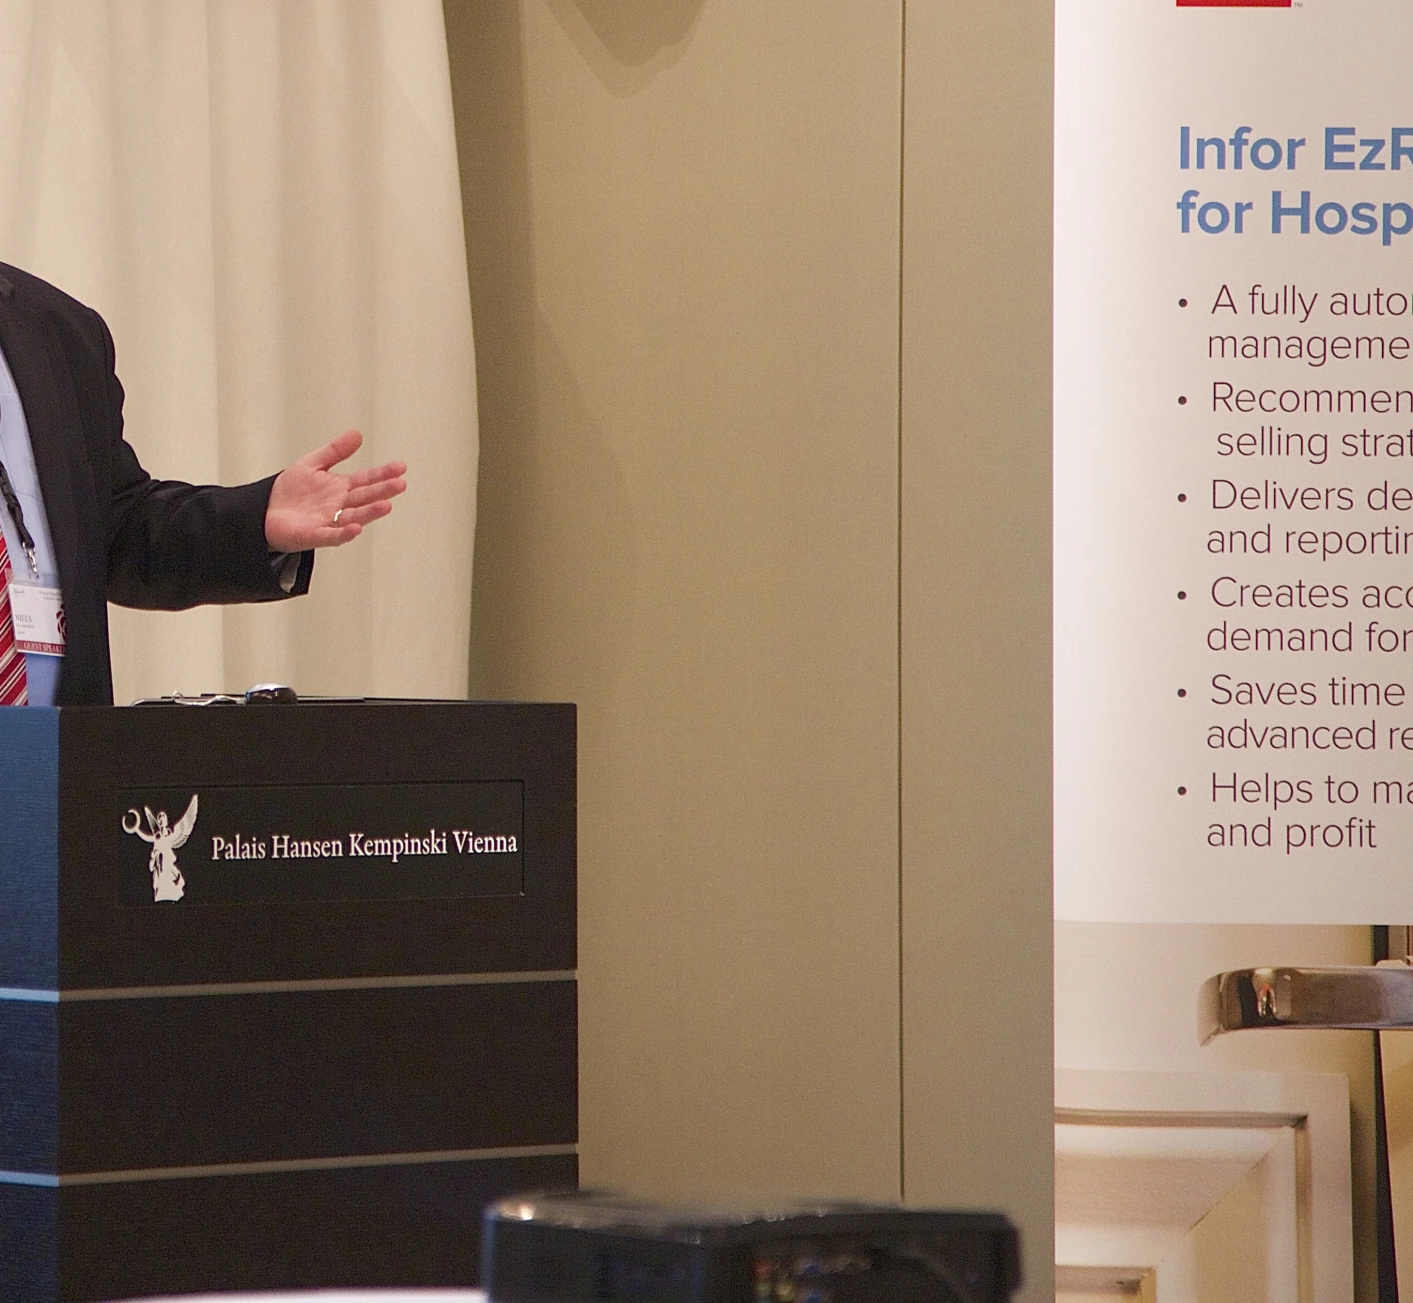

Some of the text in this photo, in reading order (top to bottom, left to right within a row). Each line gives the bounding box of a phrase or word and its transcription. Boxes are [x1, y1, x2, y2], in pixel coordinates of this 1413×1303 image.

[1181, 126, 1306, 170] Infor
[1177, 190, 1413, 246] for Hosp
[1211, 284, 1413, 323] A fully auto
[1209, 336, 1410, 367] manageme
[1213, 382, 1413, 413] Recommen
[1218, 426, 1413, 464] selling strat
[1213, 479, 1413, 511] Delivers de
[1207, 523, 1270, 553] and
[1212, 577, 1348, 608] Creates
[24, 642, 42, 652] GUEST
[1207, 621, 1413, 652] demand for
[1212, 674, 1405, 706] Saves time
[1207, 719, 1375, 750] advanced
[1213, 772, 1313, 810] Helps
[1324, 776, 1358, 803] to
[212, 829, 518, 862] Palais Hansen Kempinski Vienna
[1208, 817, 1377, 855] and profit
